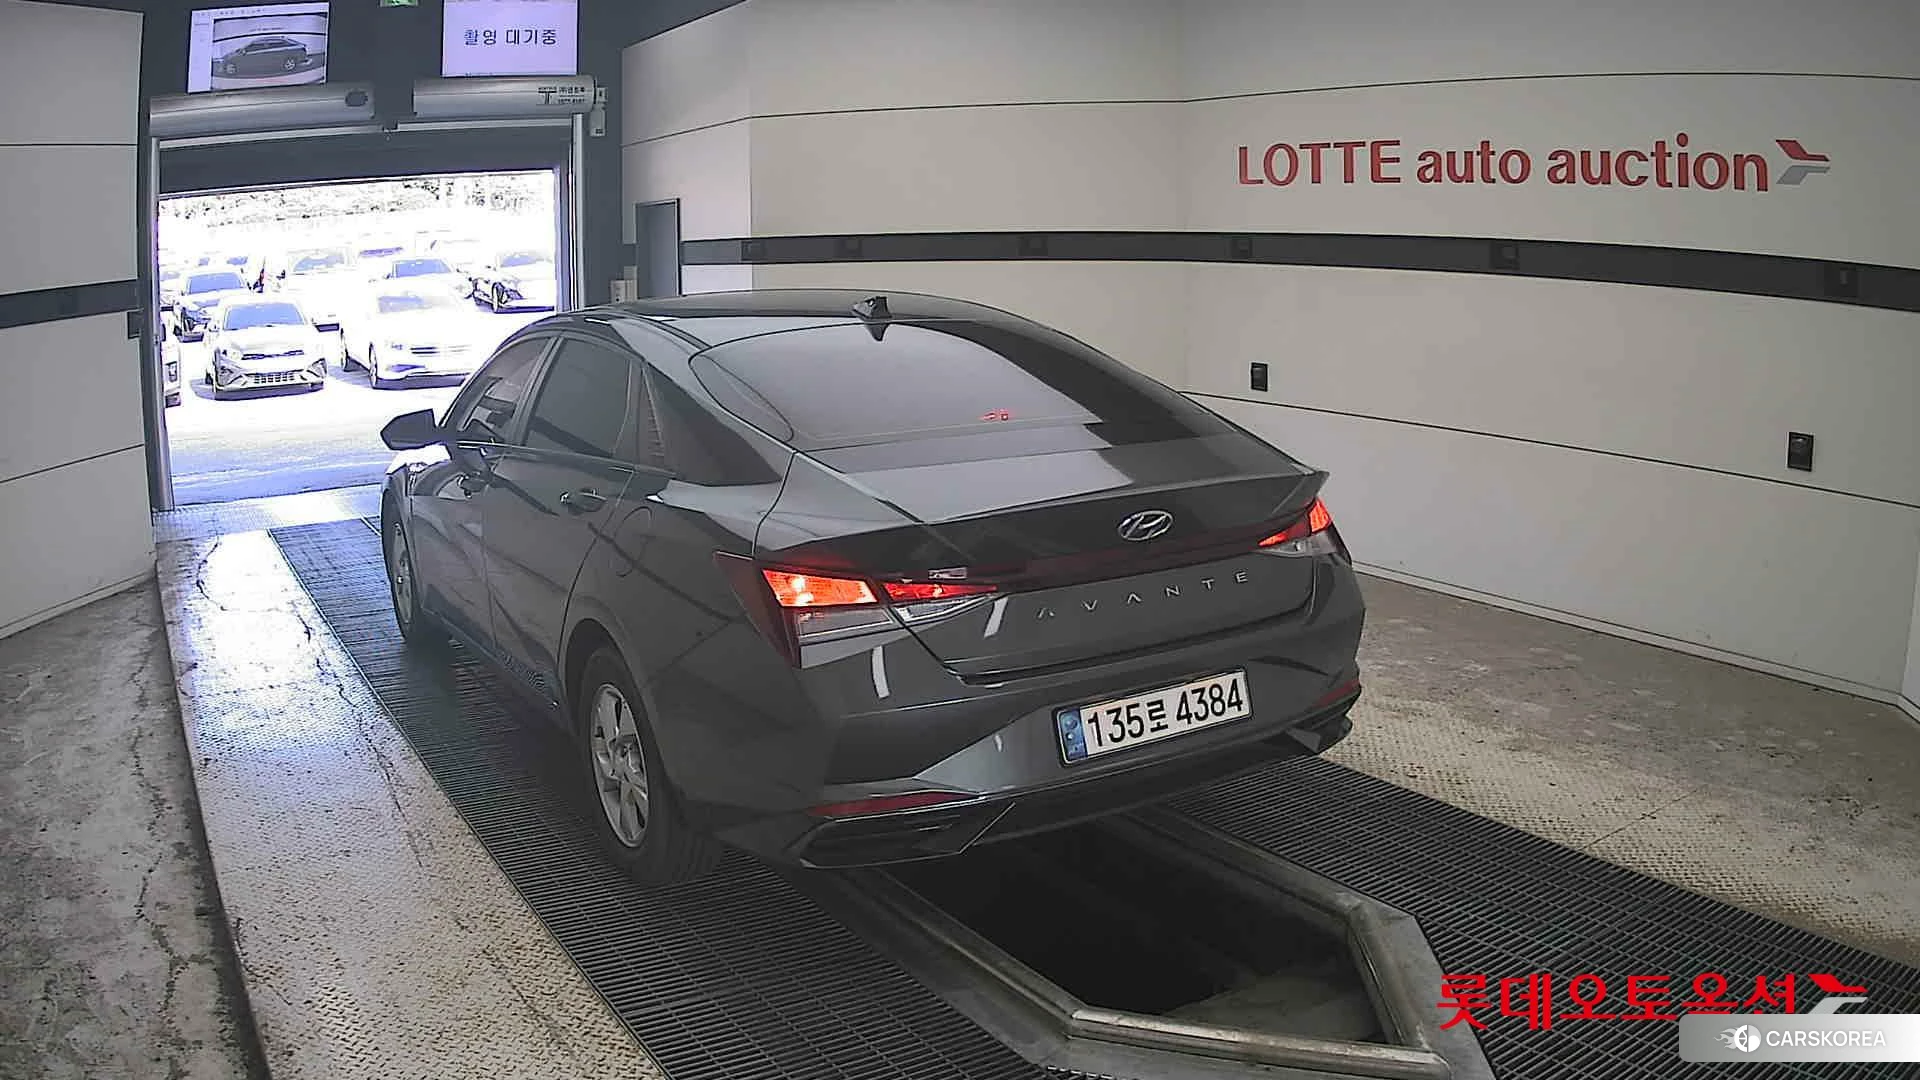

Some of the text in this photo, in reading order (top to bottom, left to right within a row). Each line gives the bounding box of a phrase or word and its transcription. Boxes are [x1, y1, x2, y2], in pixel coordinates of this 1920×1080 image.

[464, 29, 557, 46] 촬영 대기중
[1238, 132, 1769, 192] LOTTE auto auction
[1037, 571, 1249, 619] AVANTE
[1087, 678, 1243, 747] 135로 4384
